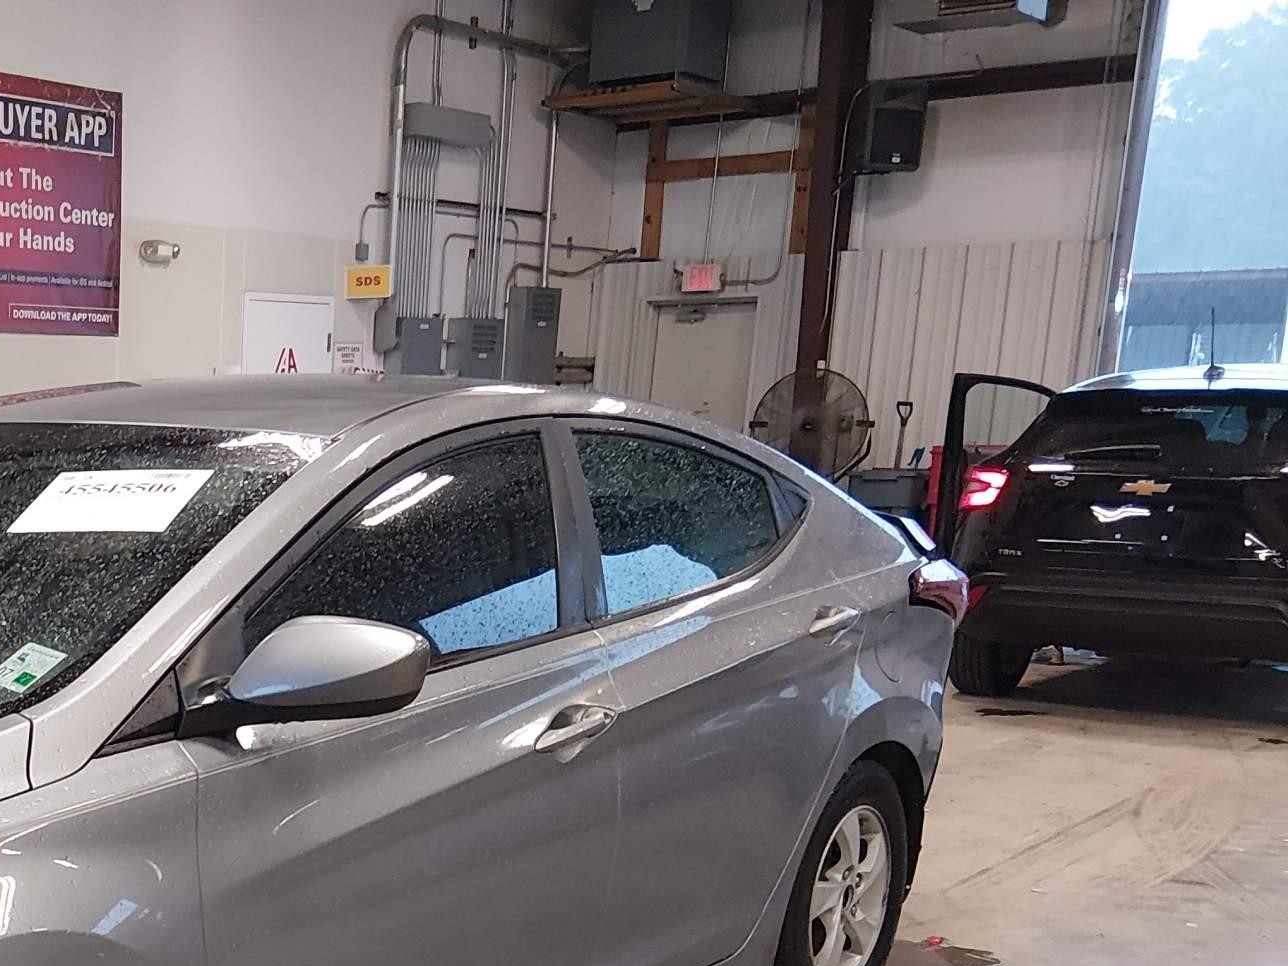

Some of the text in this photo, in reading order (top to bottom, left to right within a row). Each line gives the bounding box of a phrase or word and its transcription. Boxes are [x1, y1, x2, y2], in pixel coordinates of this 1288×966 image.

[64, 111, 108, 147] APP
[19, 167, 53, 191] The
[59, 202, 114, 228] Center
[19, 228, 74, 253] Hands
[355, 275, 381, 286] SDS
[13, 309, 57, 321] DOWNLOAD
[58, 312, 71, 321] THE
[72, 312, 87, 322] APP
